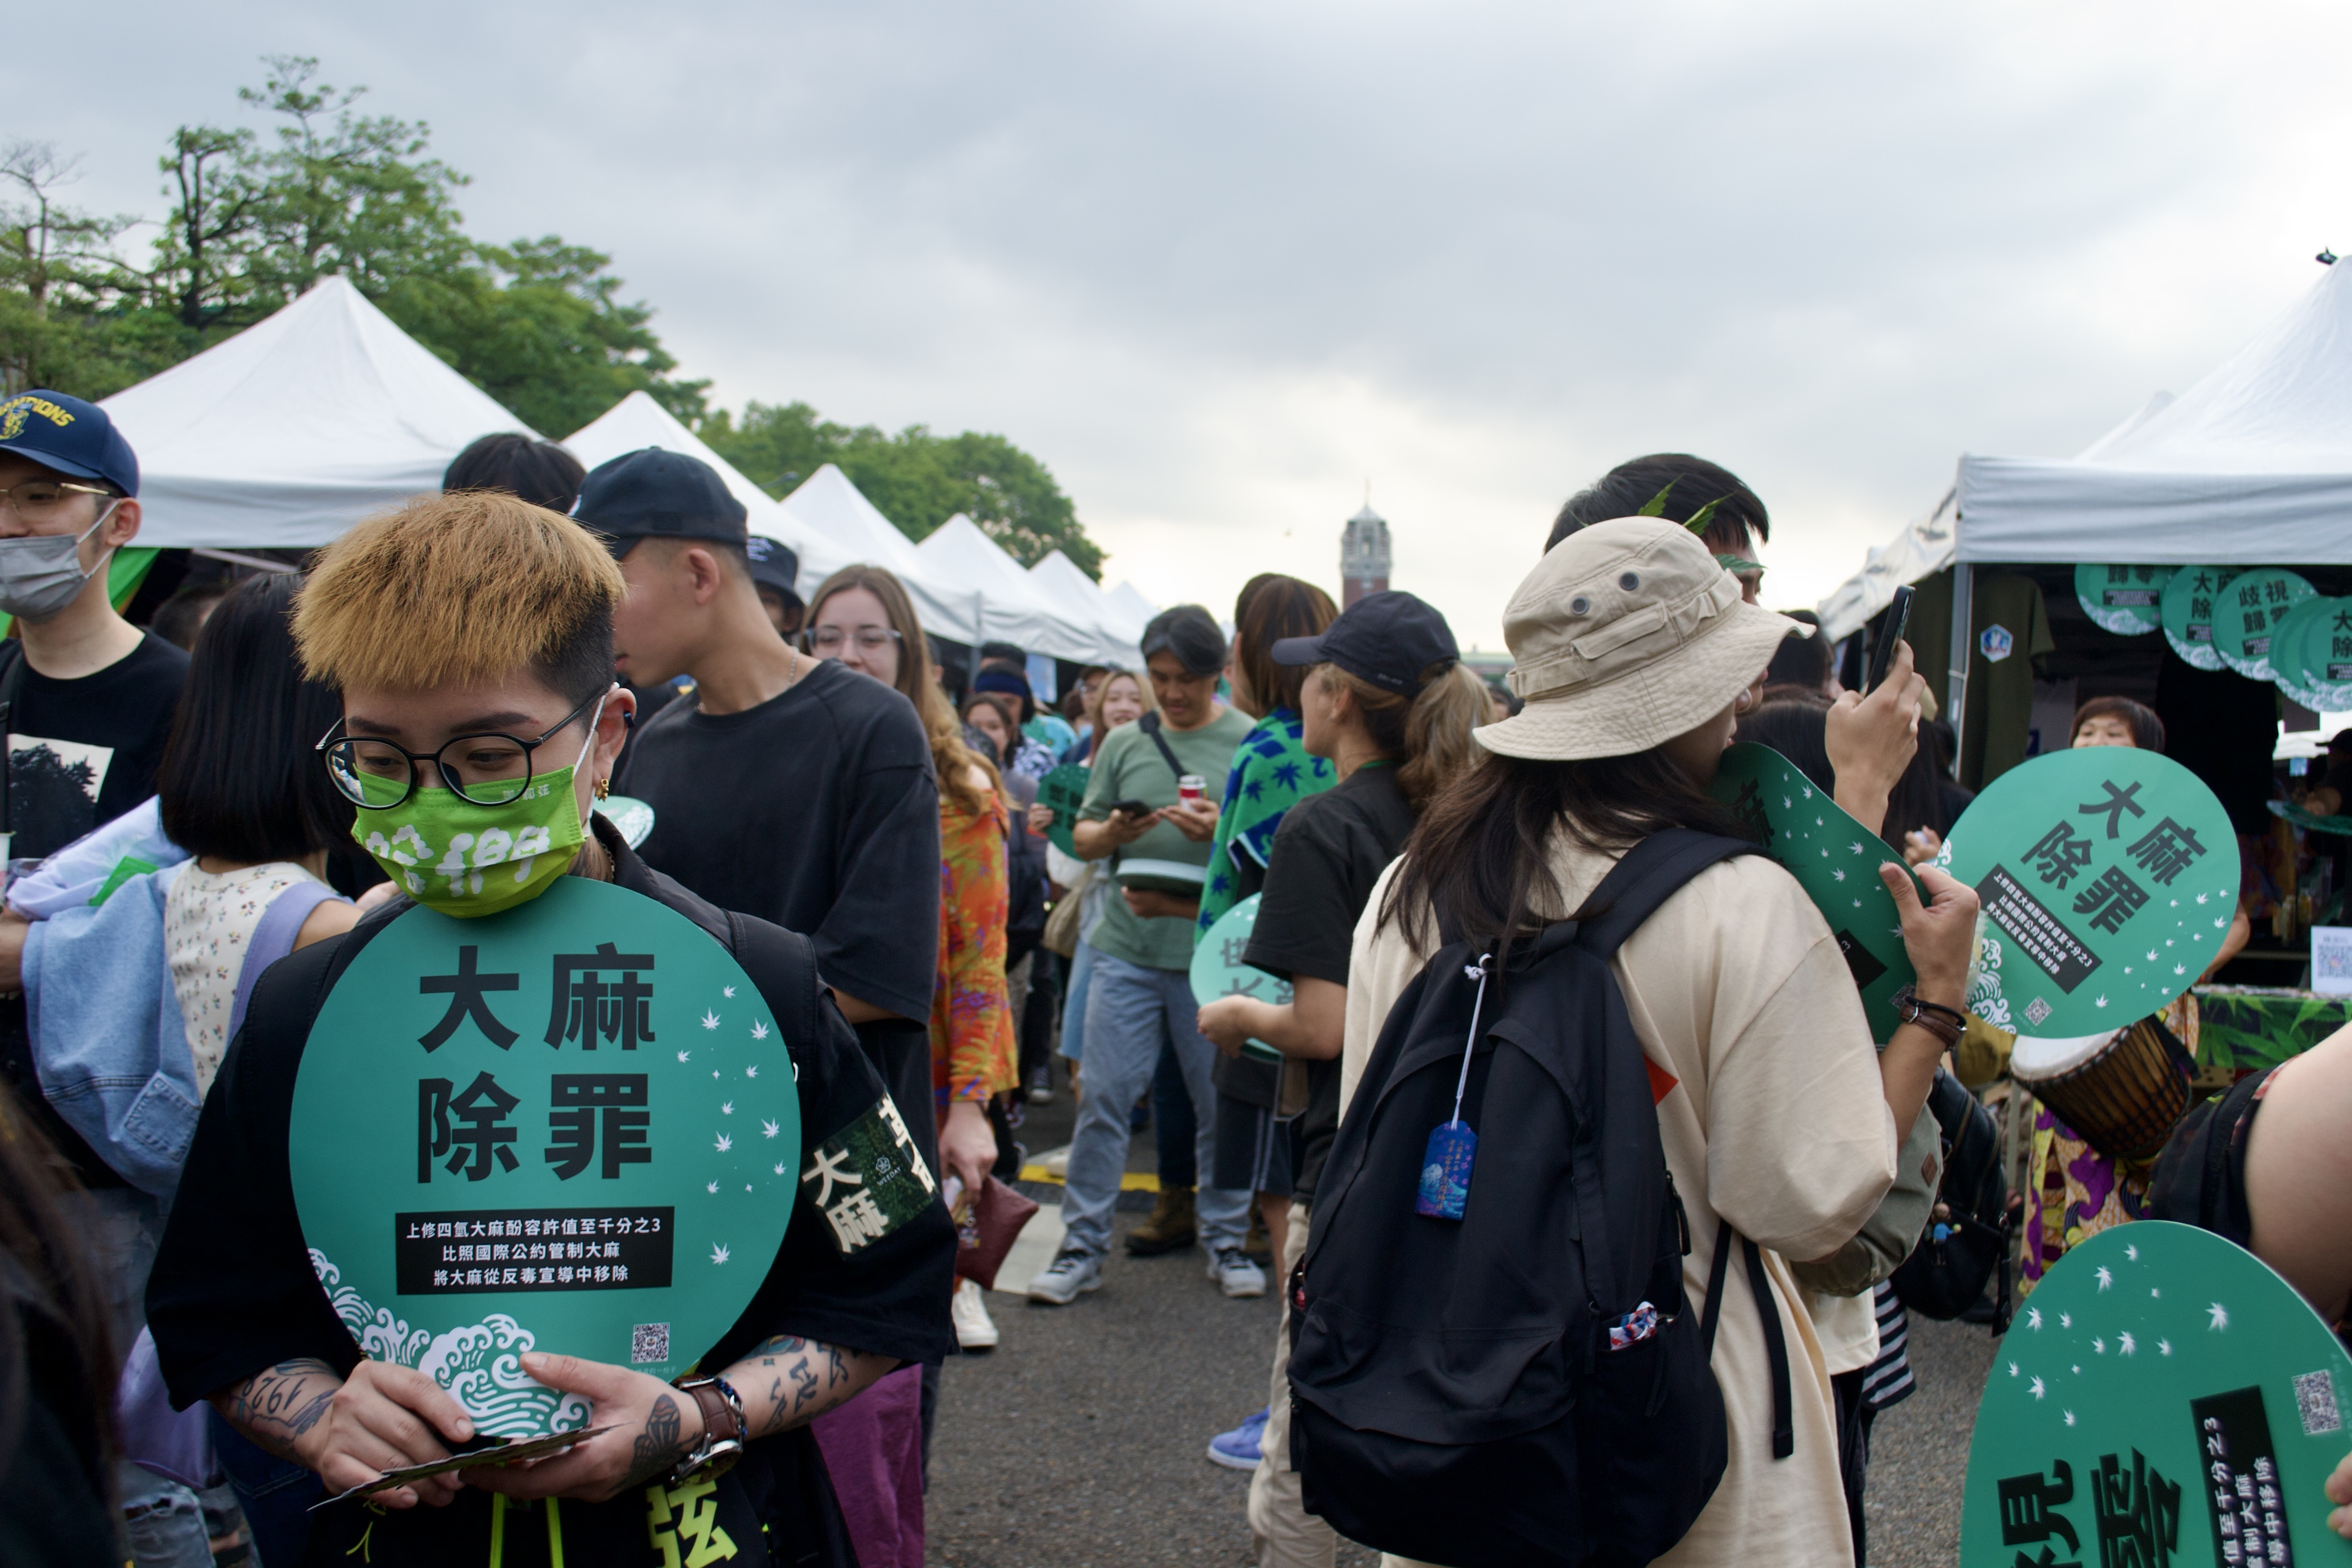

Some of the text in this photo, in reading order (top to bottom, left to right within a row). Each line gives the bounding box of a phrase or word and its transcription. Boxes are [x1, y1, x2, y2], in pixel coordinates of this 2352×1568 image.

[2020, 820, 2150, 935] 除罪
[2078, 779, 2207, 887] 大麻
[417, 941, 656, 1054] 大麻
[418, 1070, 652, 1184] 除罪
[406, 1216, 661, 1239] 上修四氫大麻酚容許值至千分之3
[433, 1264, 629, 1287] 將大麻從反毒宣導中移除
[442, 1241, 620, 1262] 比照國際公約管制大麻
